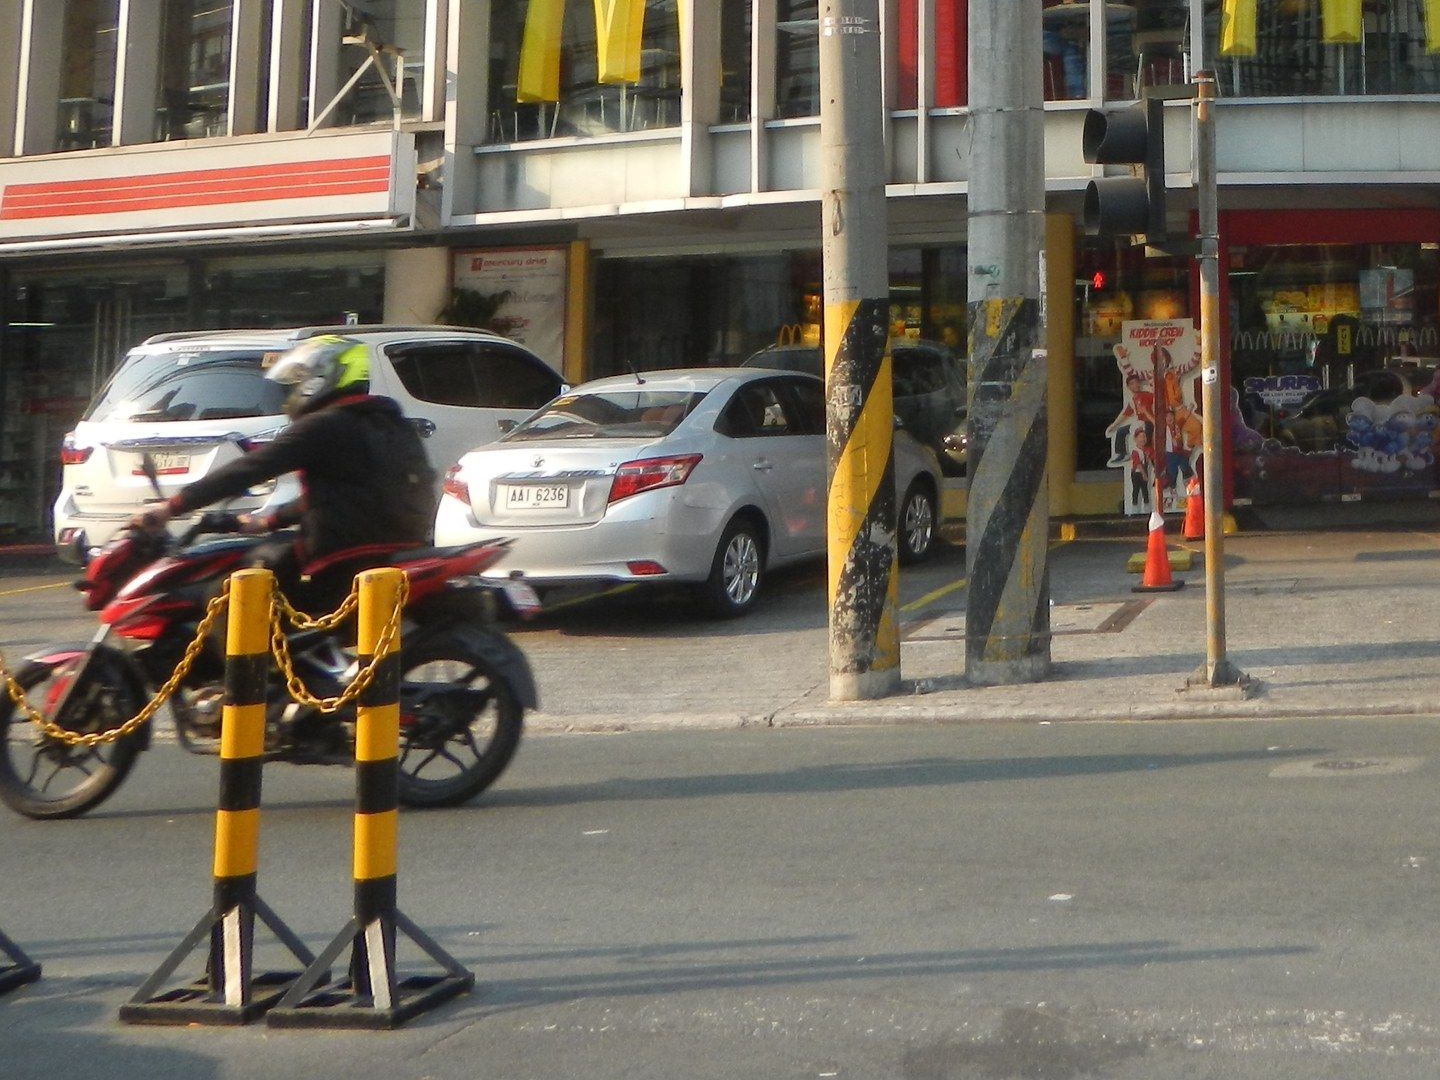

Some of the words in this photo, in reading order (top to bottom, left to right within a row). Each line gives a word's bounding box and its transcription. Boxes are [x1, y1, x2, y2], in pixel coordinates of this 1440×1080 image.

[1129, 328, 1159, 339] KIDDIE
[1159, 327, 1185, 338] CREW
[536, 487, 565, 501] 6236
